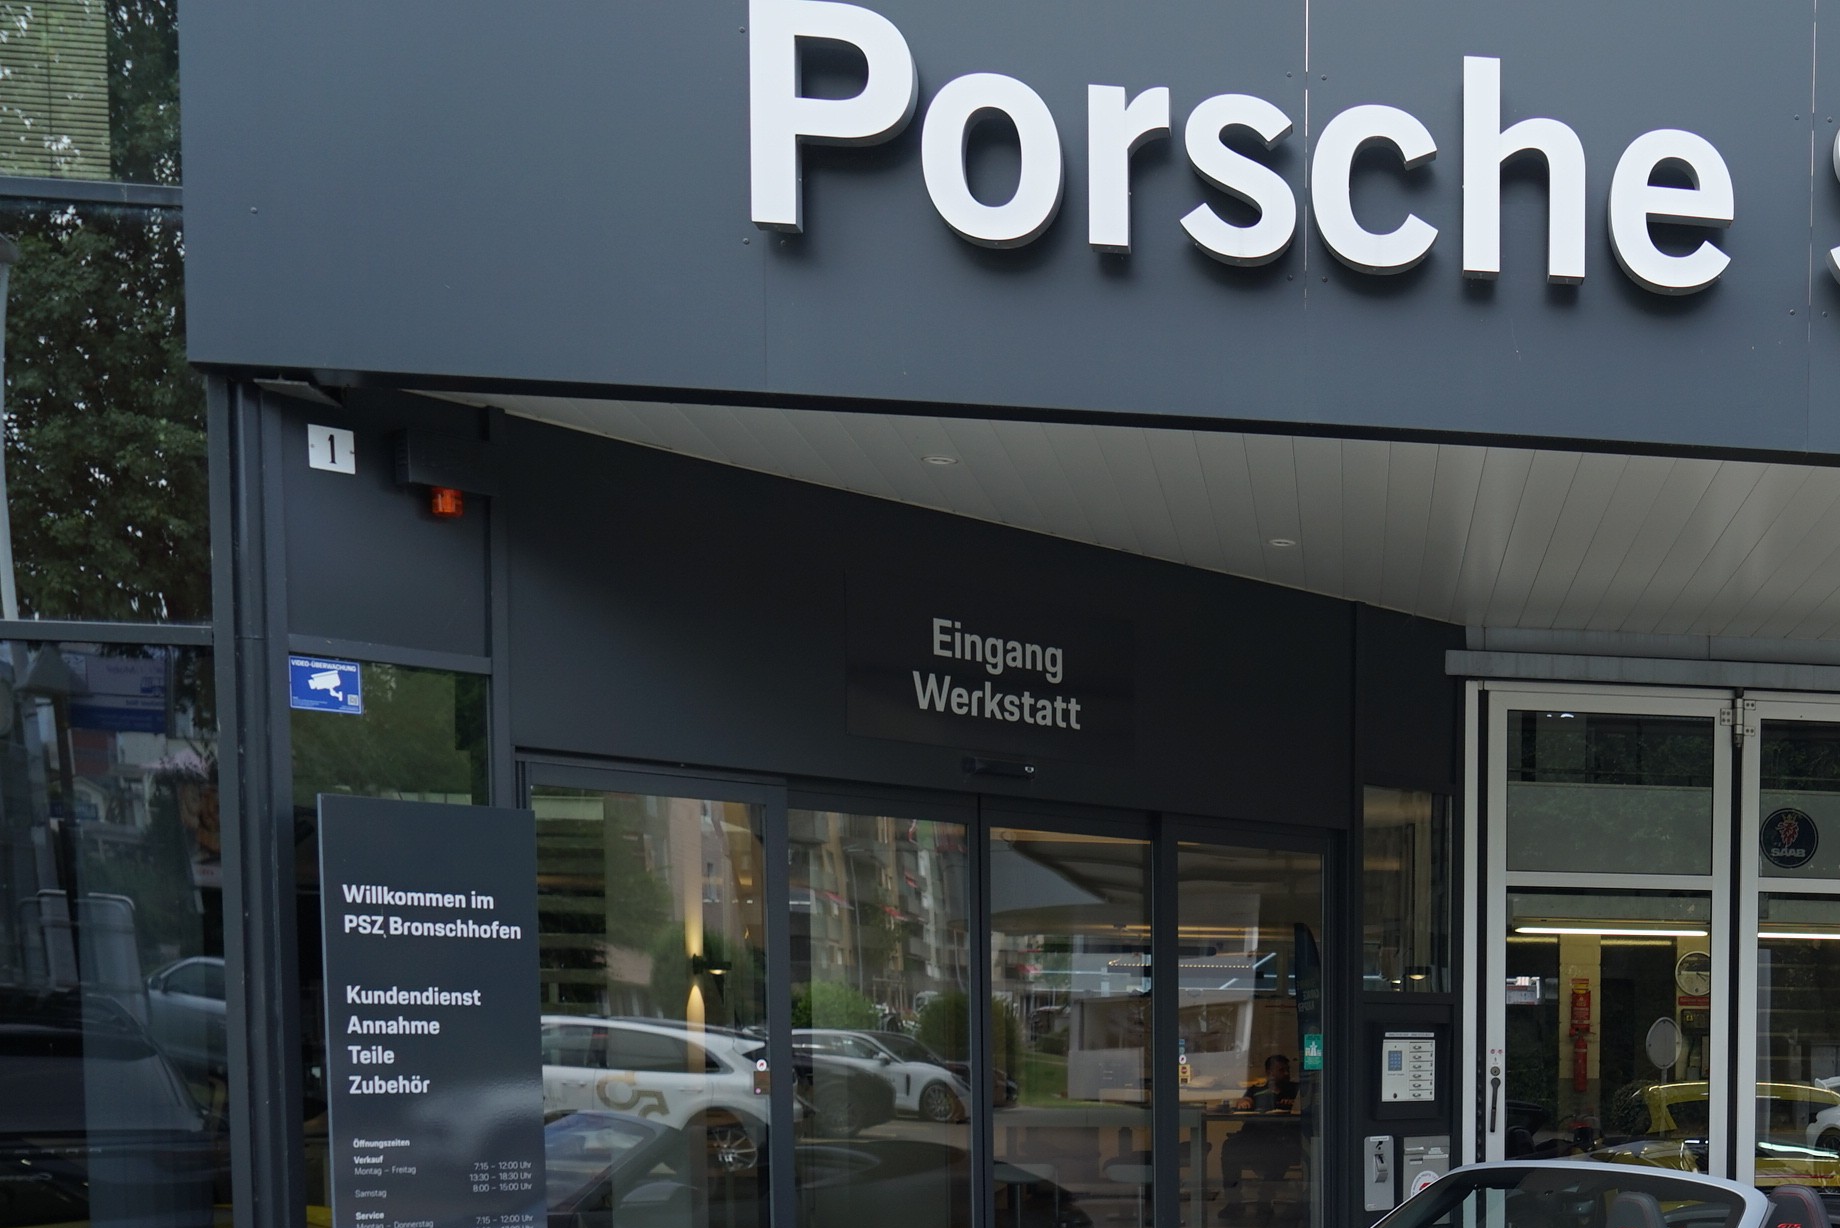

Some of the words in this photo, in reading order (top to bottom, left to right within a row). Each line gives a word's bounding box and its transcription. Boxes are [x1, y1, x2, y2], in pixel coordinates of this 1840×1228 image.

[749, 0, 1734, 297] Porsche
[327, 434, 338, 465] 1
[932, 617, 1063, 684] Eingang
[291, 660, 356, 672] VIDEO-ÜBERWACHUNG
[912, 670, 1081, 731] Werkstatt
[1770, 847, 1806, 858] SAAB
[342, 884, 466, 908] Willkommen
[471, 891, 495, 910] im
[344, 915, 384, 935] PSZ
[389, 918, 522, 940] Bronschhofen
[346, 985, 482, 1006] Kundendienst
[347, 1016, 440, 1035] Annahme
[348, 1046, 395, 1065] Teile
[349, 1075, 431, 1095] Zubehör
[353, 1138, 411, 1149] Öffnungszeiten
[353, 1155, 384, 1164] Verkauf
[519, 1161, 532, 1169] Uhr
[354, 1167, 382, 1176] Montag
[391, 1165, 417, 1175] Freitag
[520, 1172, 532, 1180] Uhr
[520, 1182, 533, 1190] Uhr
[354, 1189, 387, 1198] Samstag
[355, 1211, 385, 1220] Service
[521, 1214, 534, 1223] Uhr
